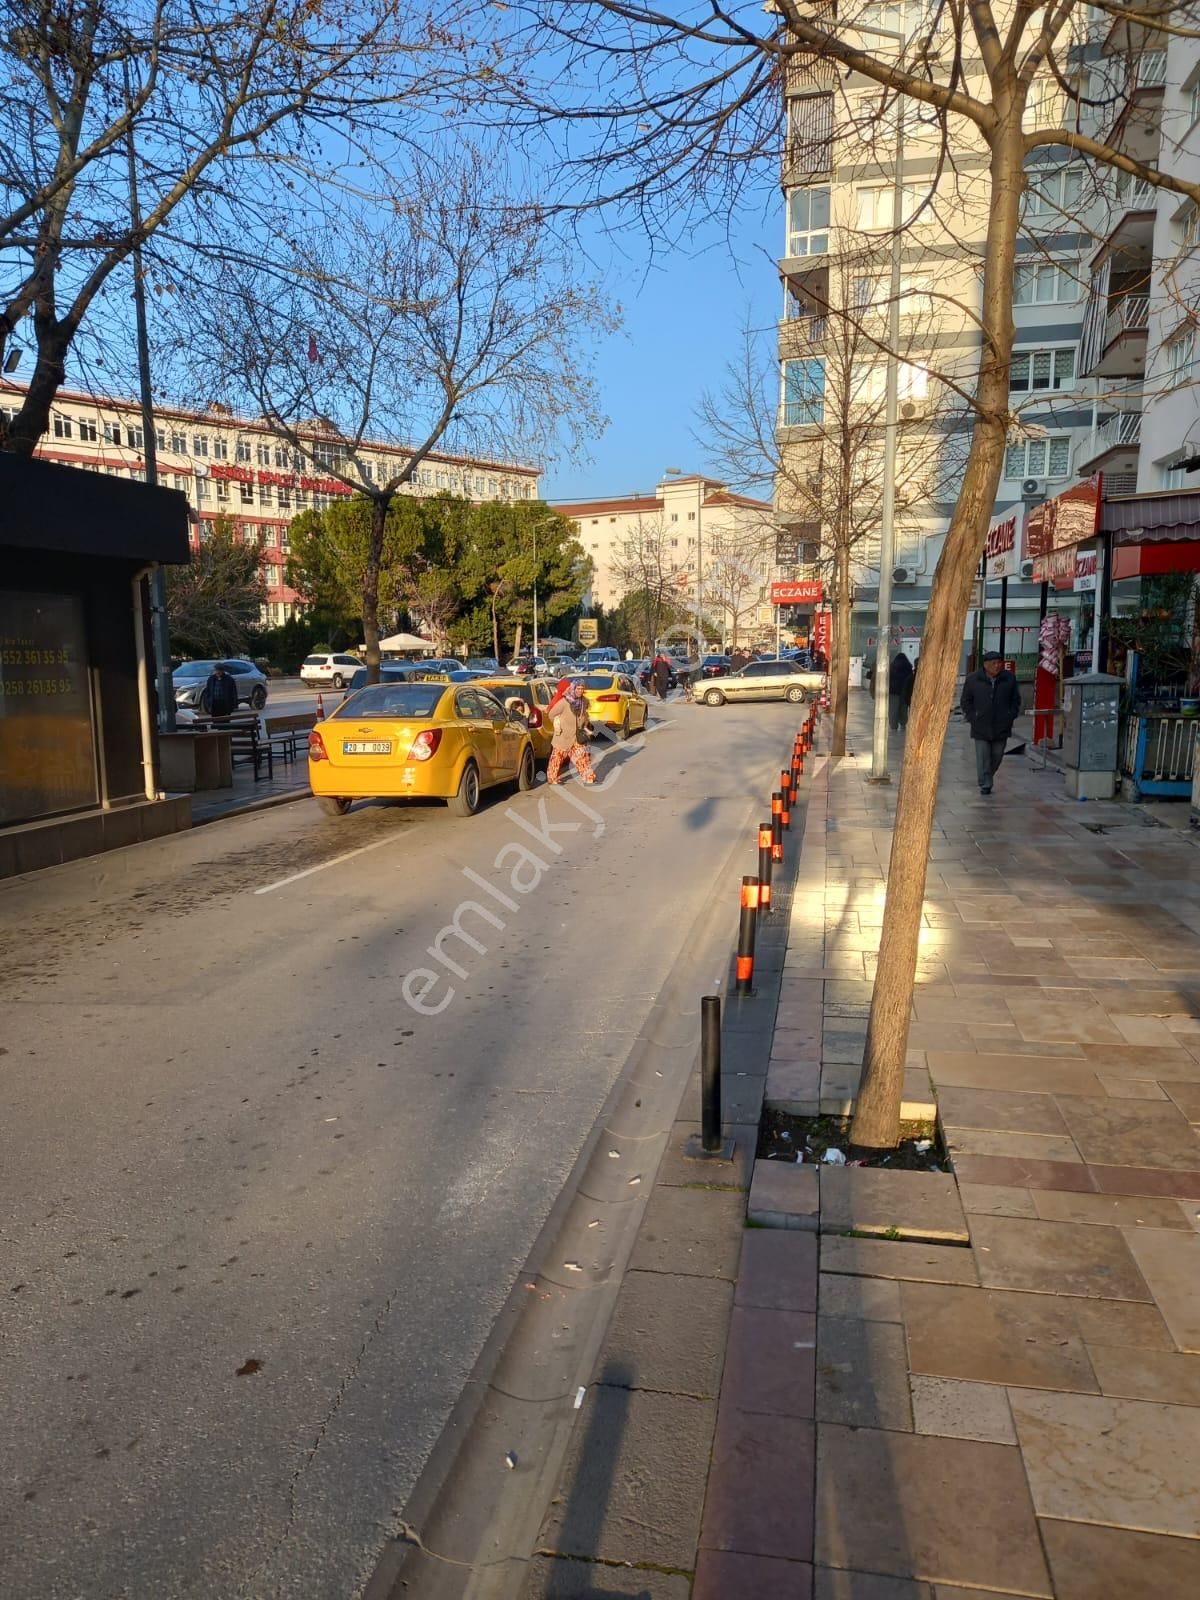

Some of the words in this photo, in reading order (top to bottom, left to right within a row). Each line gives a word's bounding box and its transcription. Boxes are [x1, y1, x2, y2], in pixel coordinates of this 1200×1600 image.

[773, 587, 818, 598] ECZANE
[818, 616, 827, 654] ECZA
[348, 743, 357, 752] 20
[362, 743, 366, 752] T
[372, 743, 390, 752] 0039
